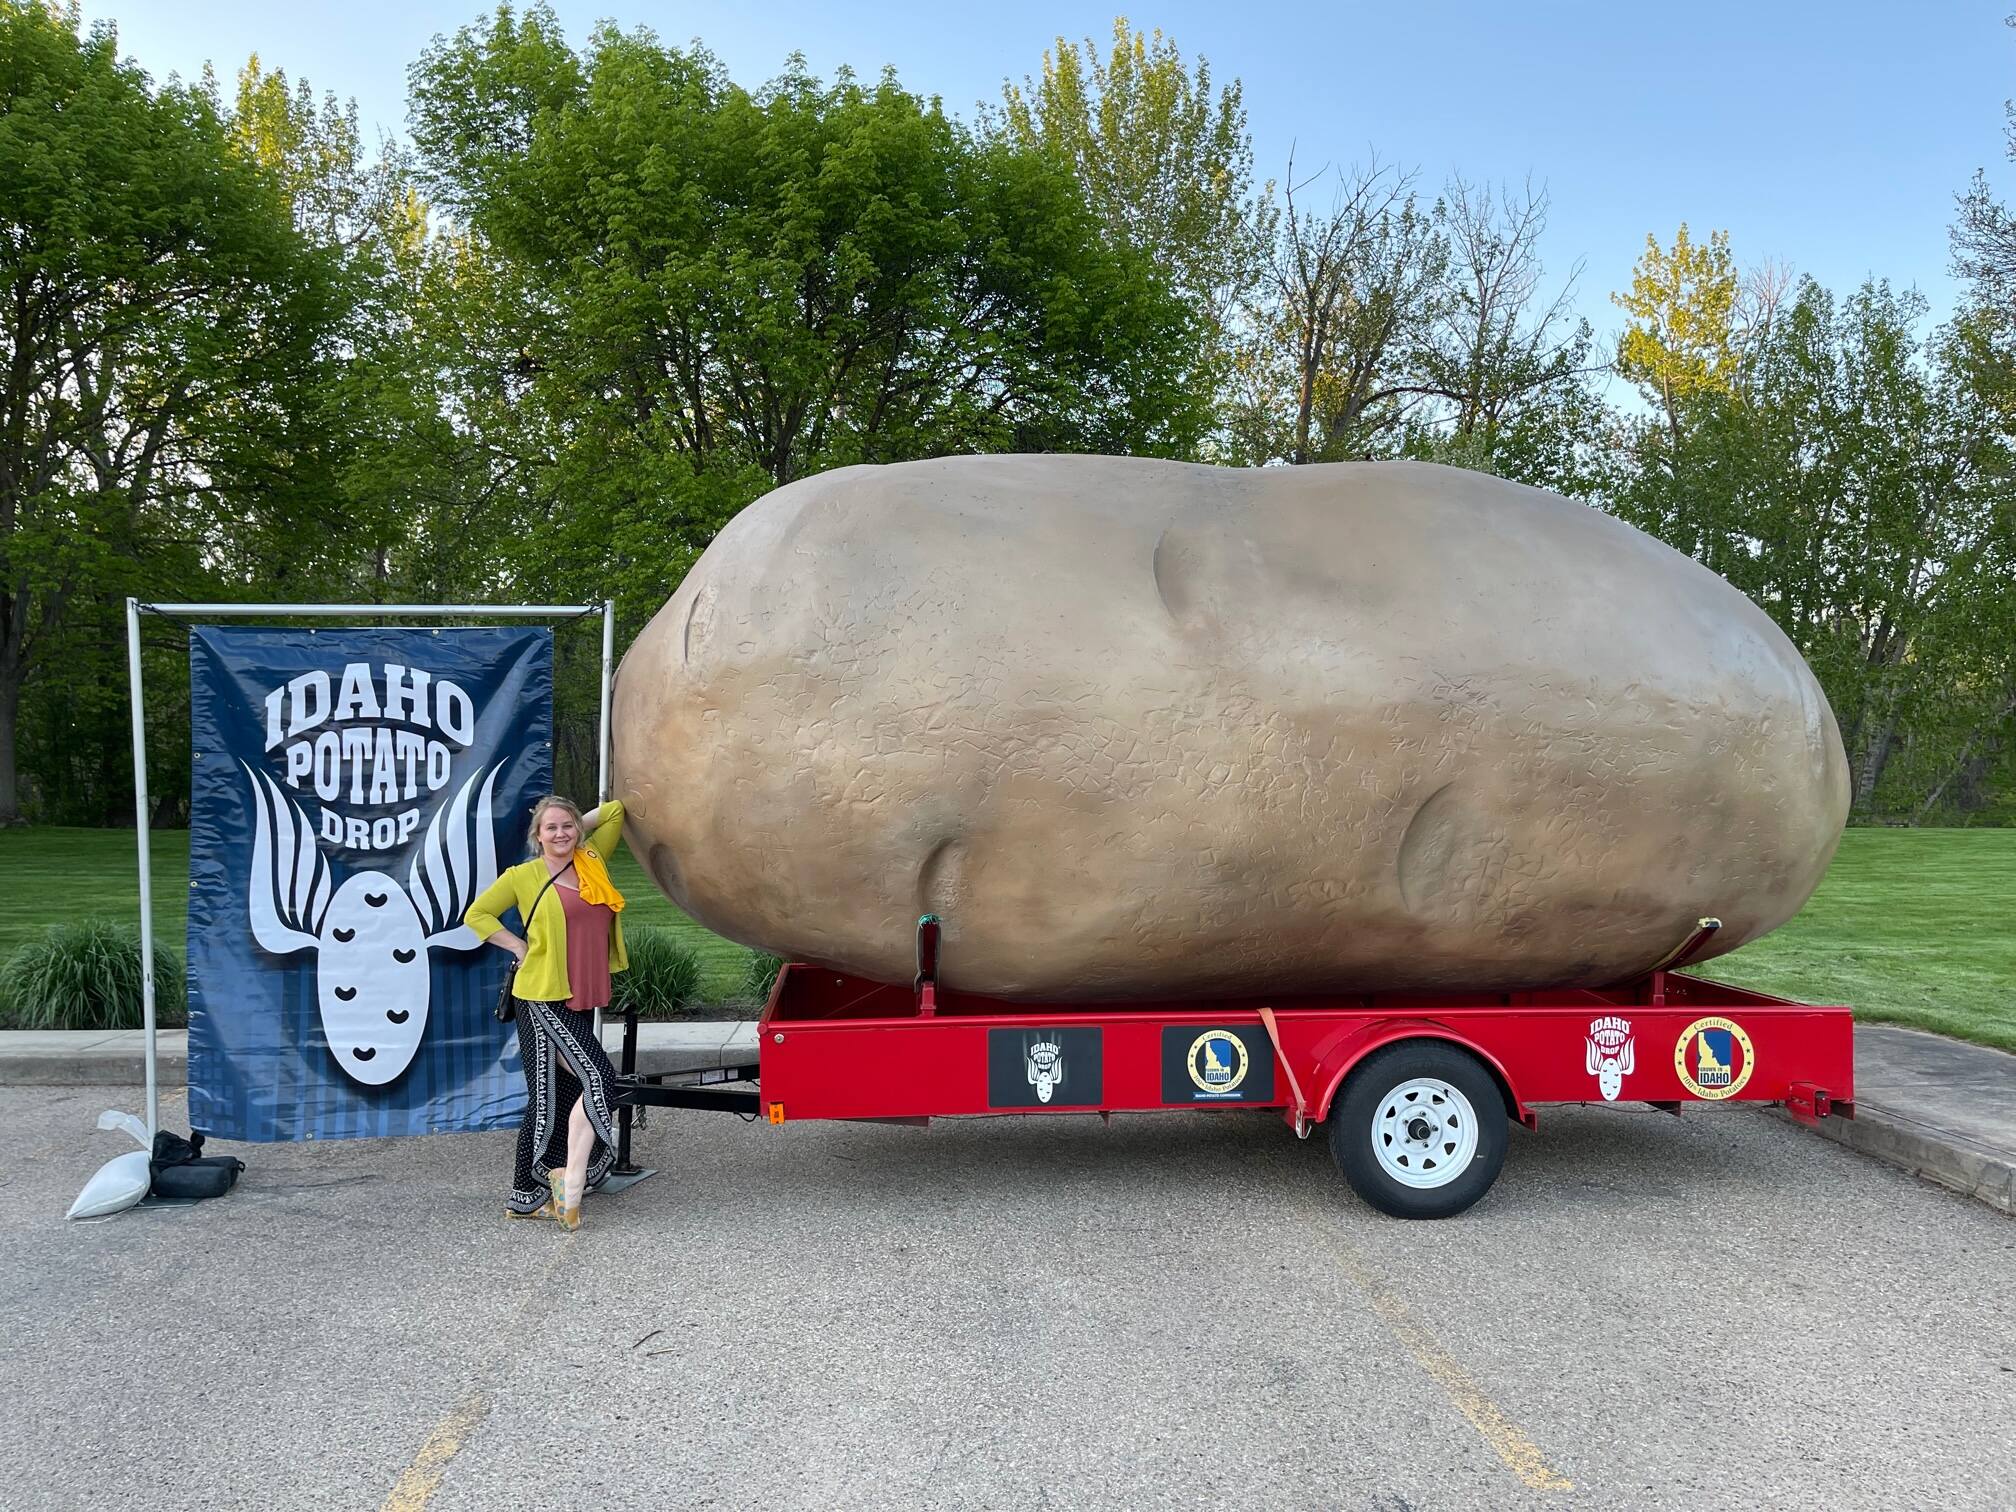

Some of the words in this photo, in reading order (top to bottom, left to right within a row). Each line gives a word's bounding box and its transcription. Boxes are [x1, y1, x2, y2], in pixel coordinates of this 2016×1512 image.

[265, 662, 474, 753] IDAHO
[286, 727, 451, 804] POTATO
[320, 806, 421, 850] DROP
[1590, 1016, 1630, 1036] IDAHO
[1693, 1019, 1733, 1030] Certified
[1594, 1030, 1626, 1046] POTATO
[1030, 1042, 1059, 1057] IDAHO
[1206, 1072, 1230, 1081] IDAHO
[1700, 1072, 1729, 1084] IDAHO
[1697, 1088, 1719, 1098] Idaho
[1720, 1076, 1747, 1097] Potatoes
